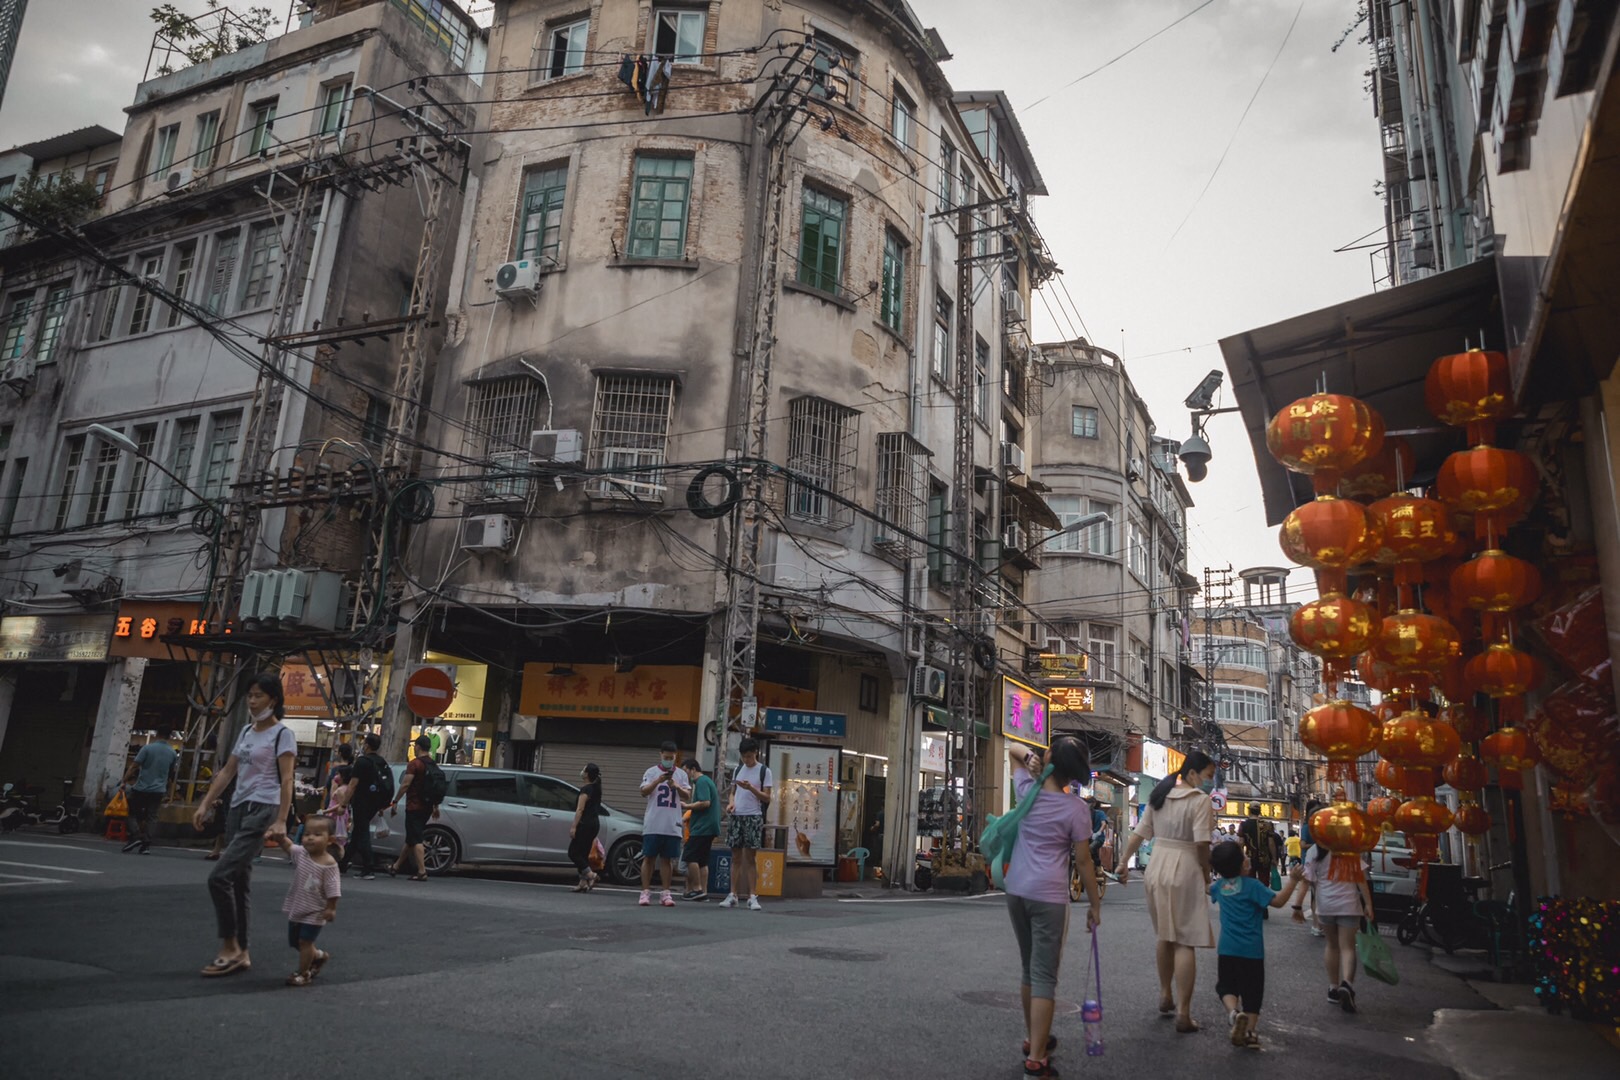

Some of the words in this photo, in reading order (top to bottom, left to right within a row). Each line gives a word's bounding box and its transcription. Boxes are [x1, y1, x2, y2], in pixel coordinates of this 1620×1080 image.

[789, 714, 823, 726] 镇邦路
[657, 785, 677, 809] 21
